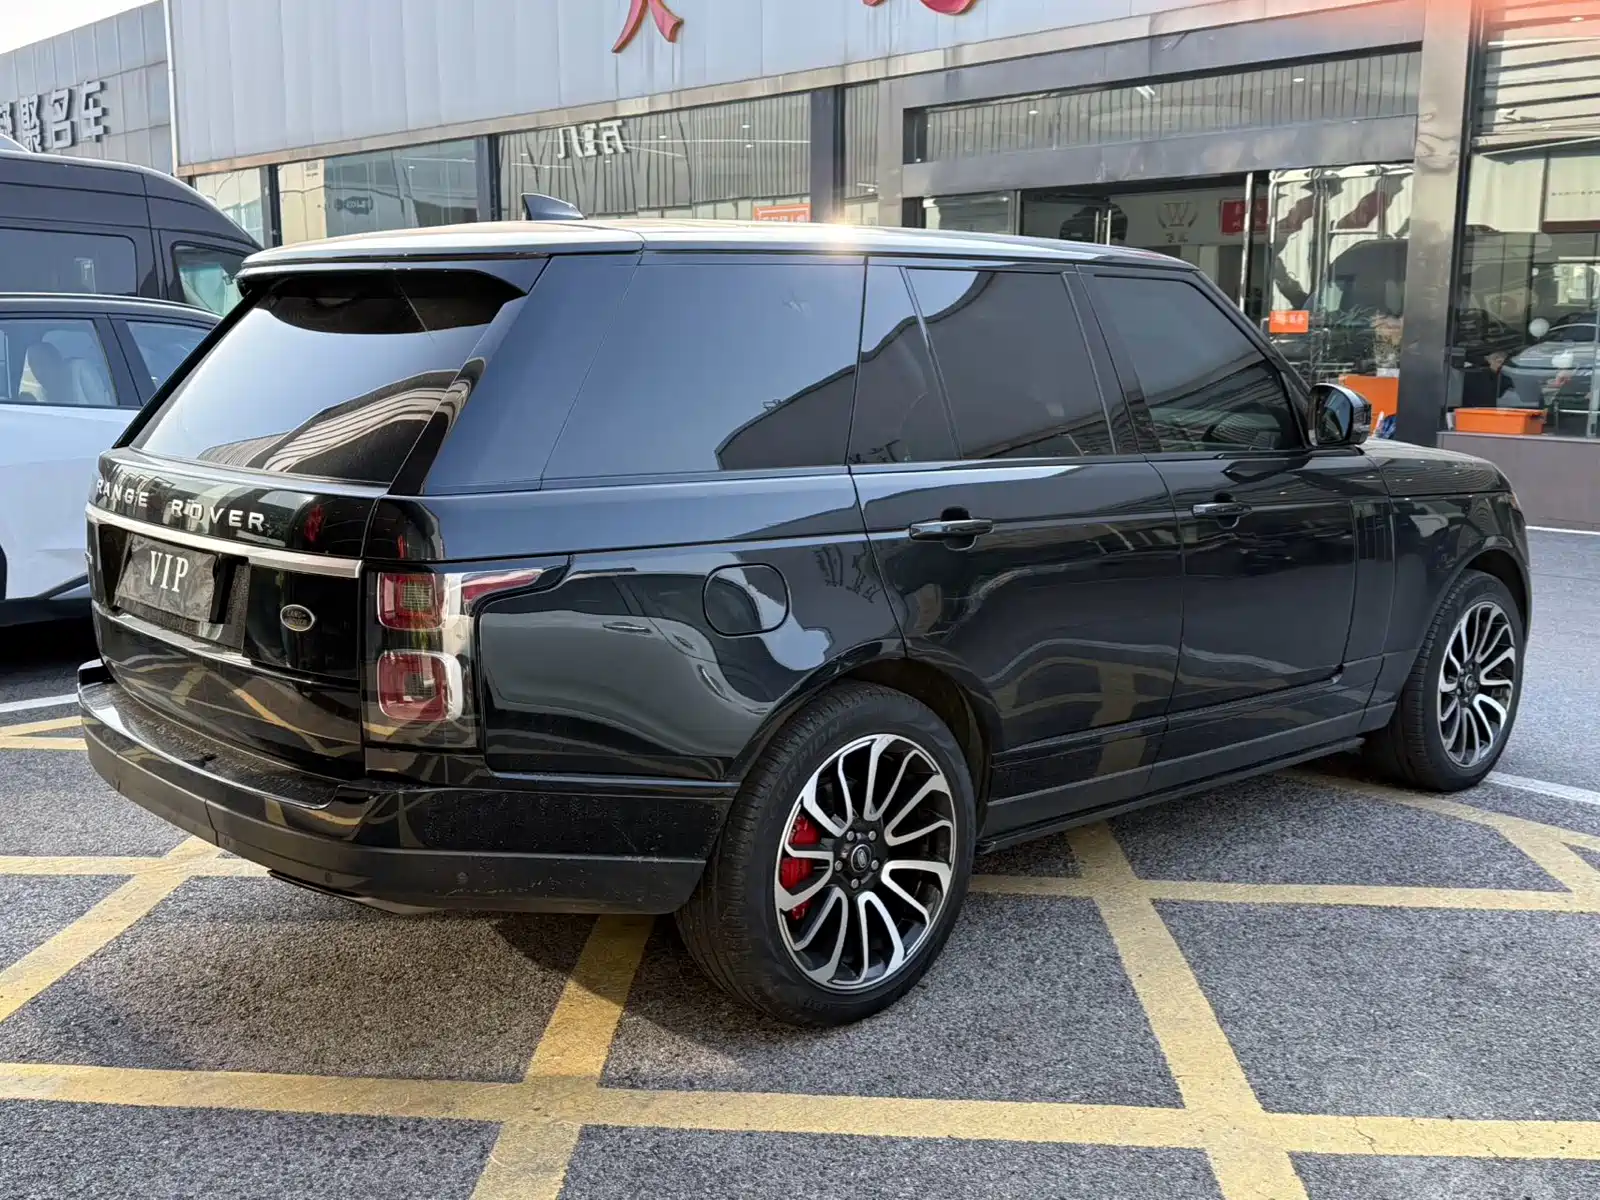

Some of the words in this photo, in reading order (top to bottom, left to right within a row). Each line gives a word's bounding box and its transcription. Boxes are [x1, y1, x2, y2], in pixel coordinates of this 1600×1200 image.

[96, 478, 149, 507] RANGE
[171, 499, 266, 532] ROVER
[149, 550, 189, 593] VIP
